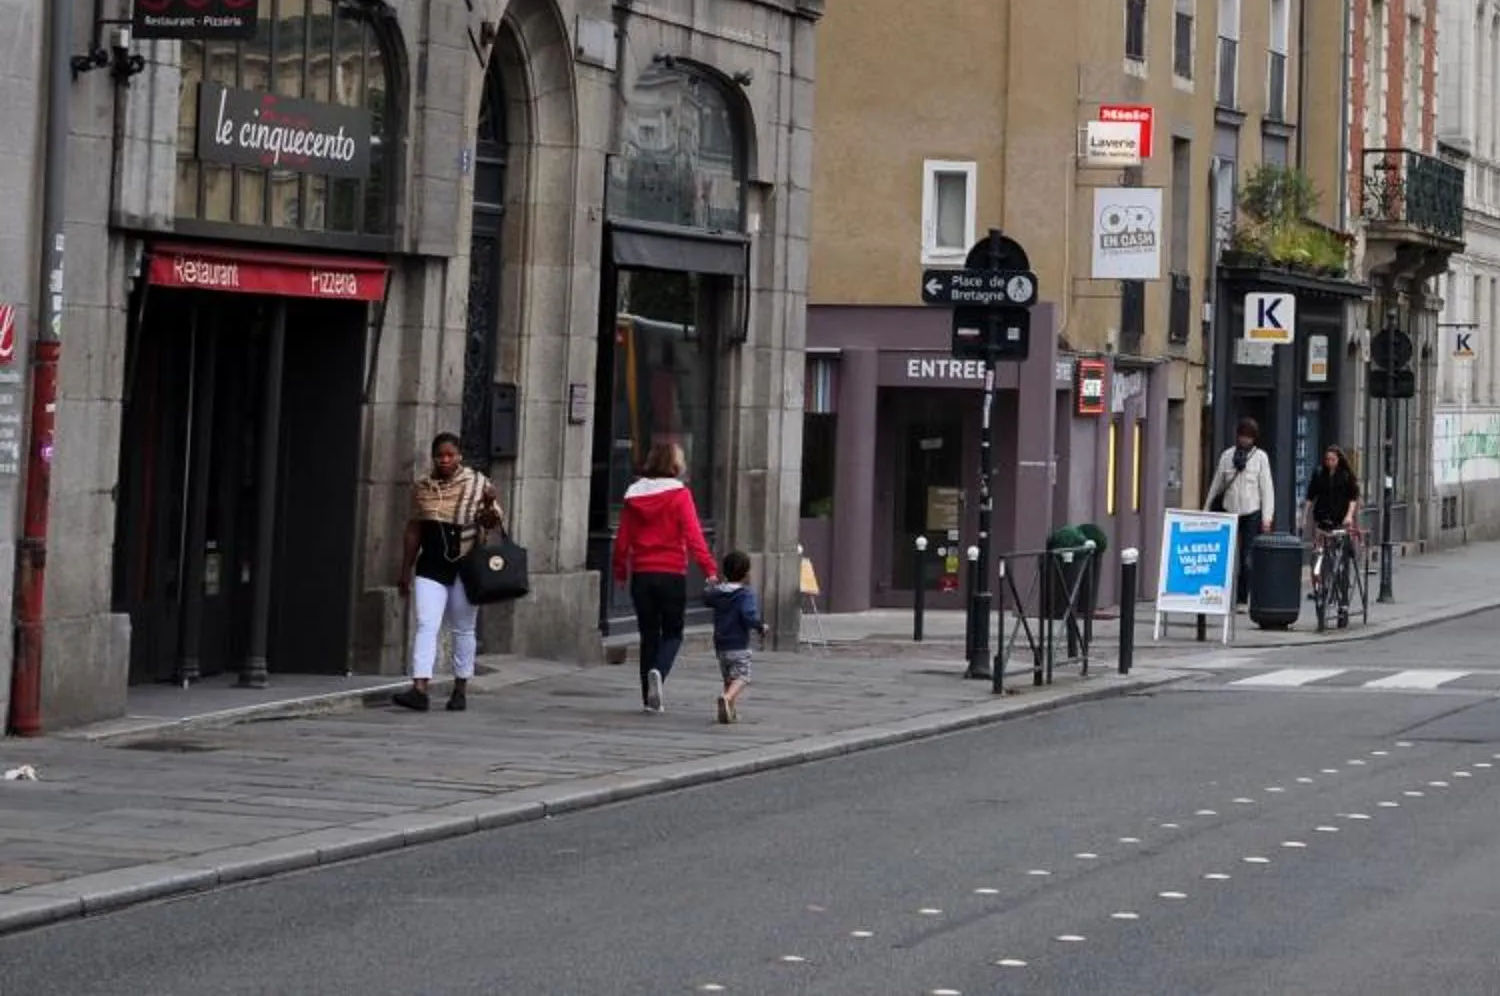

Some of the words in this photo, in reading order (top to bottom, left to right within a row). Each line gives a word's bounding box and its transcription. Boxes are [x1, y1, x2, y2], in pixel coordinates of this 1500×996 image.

[215, 87, 233, 145] le
[239, 108, 355, 165] cinquecento
[1091, 135, 1136, 149] Laverie
[174, 258, 239, 286] Restaurant
[951, 275, 983, 287] Place
[989, 276, 1005, 288] de
[951, 289, 1005, 304] Bretagne
[1257, 298, 1283, 328] K
[1457, 333, 1472, 351] K
